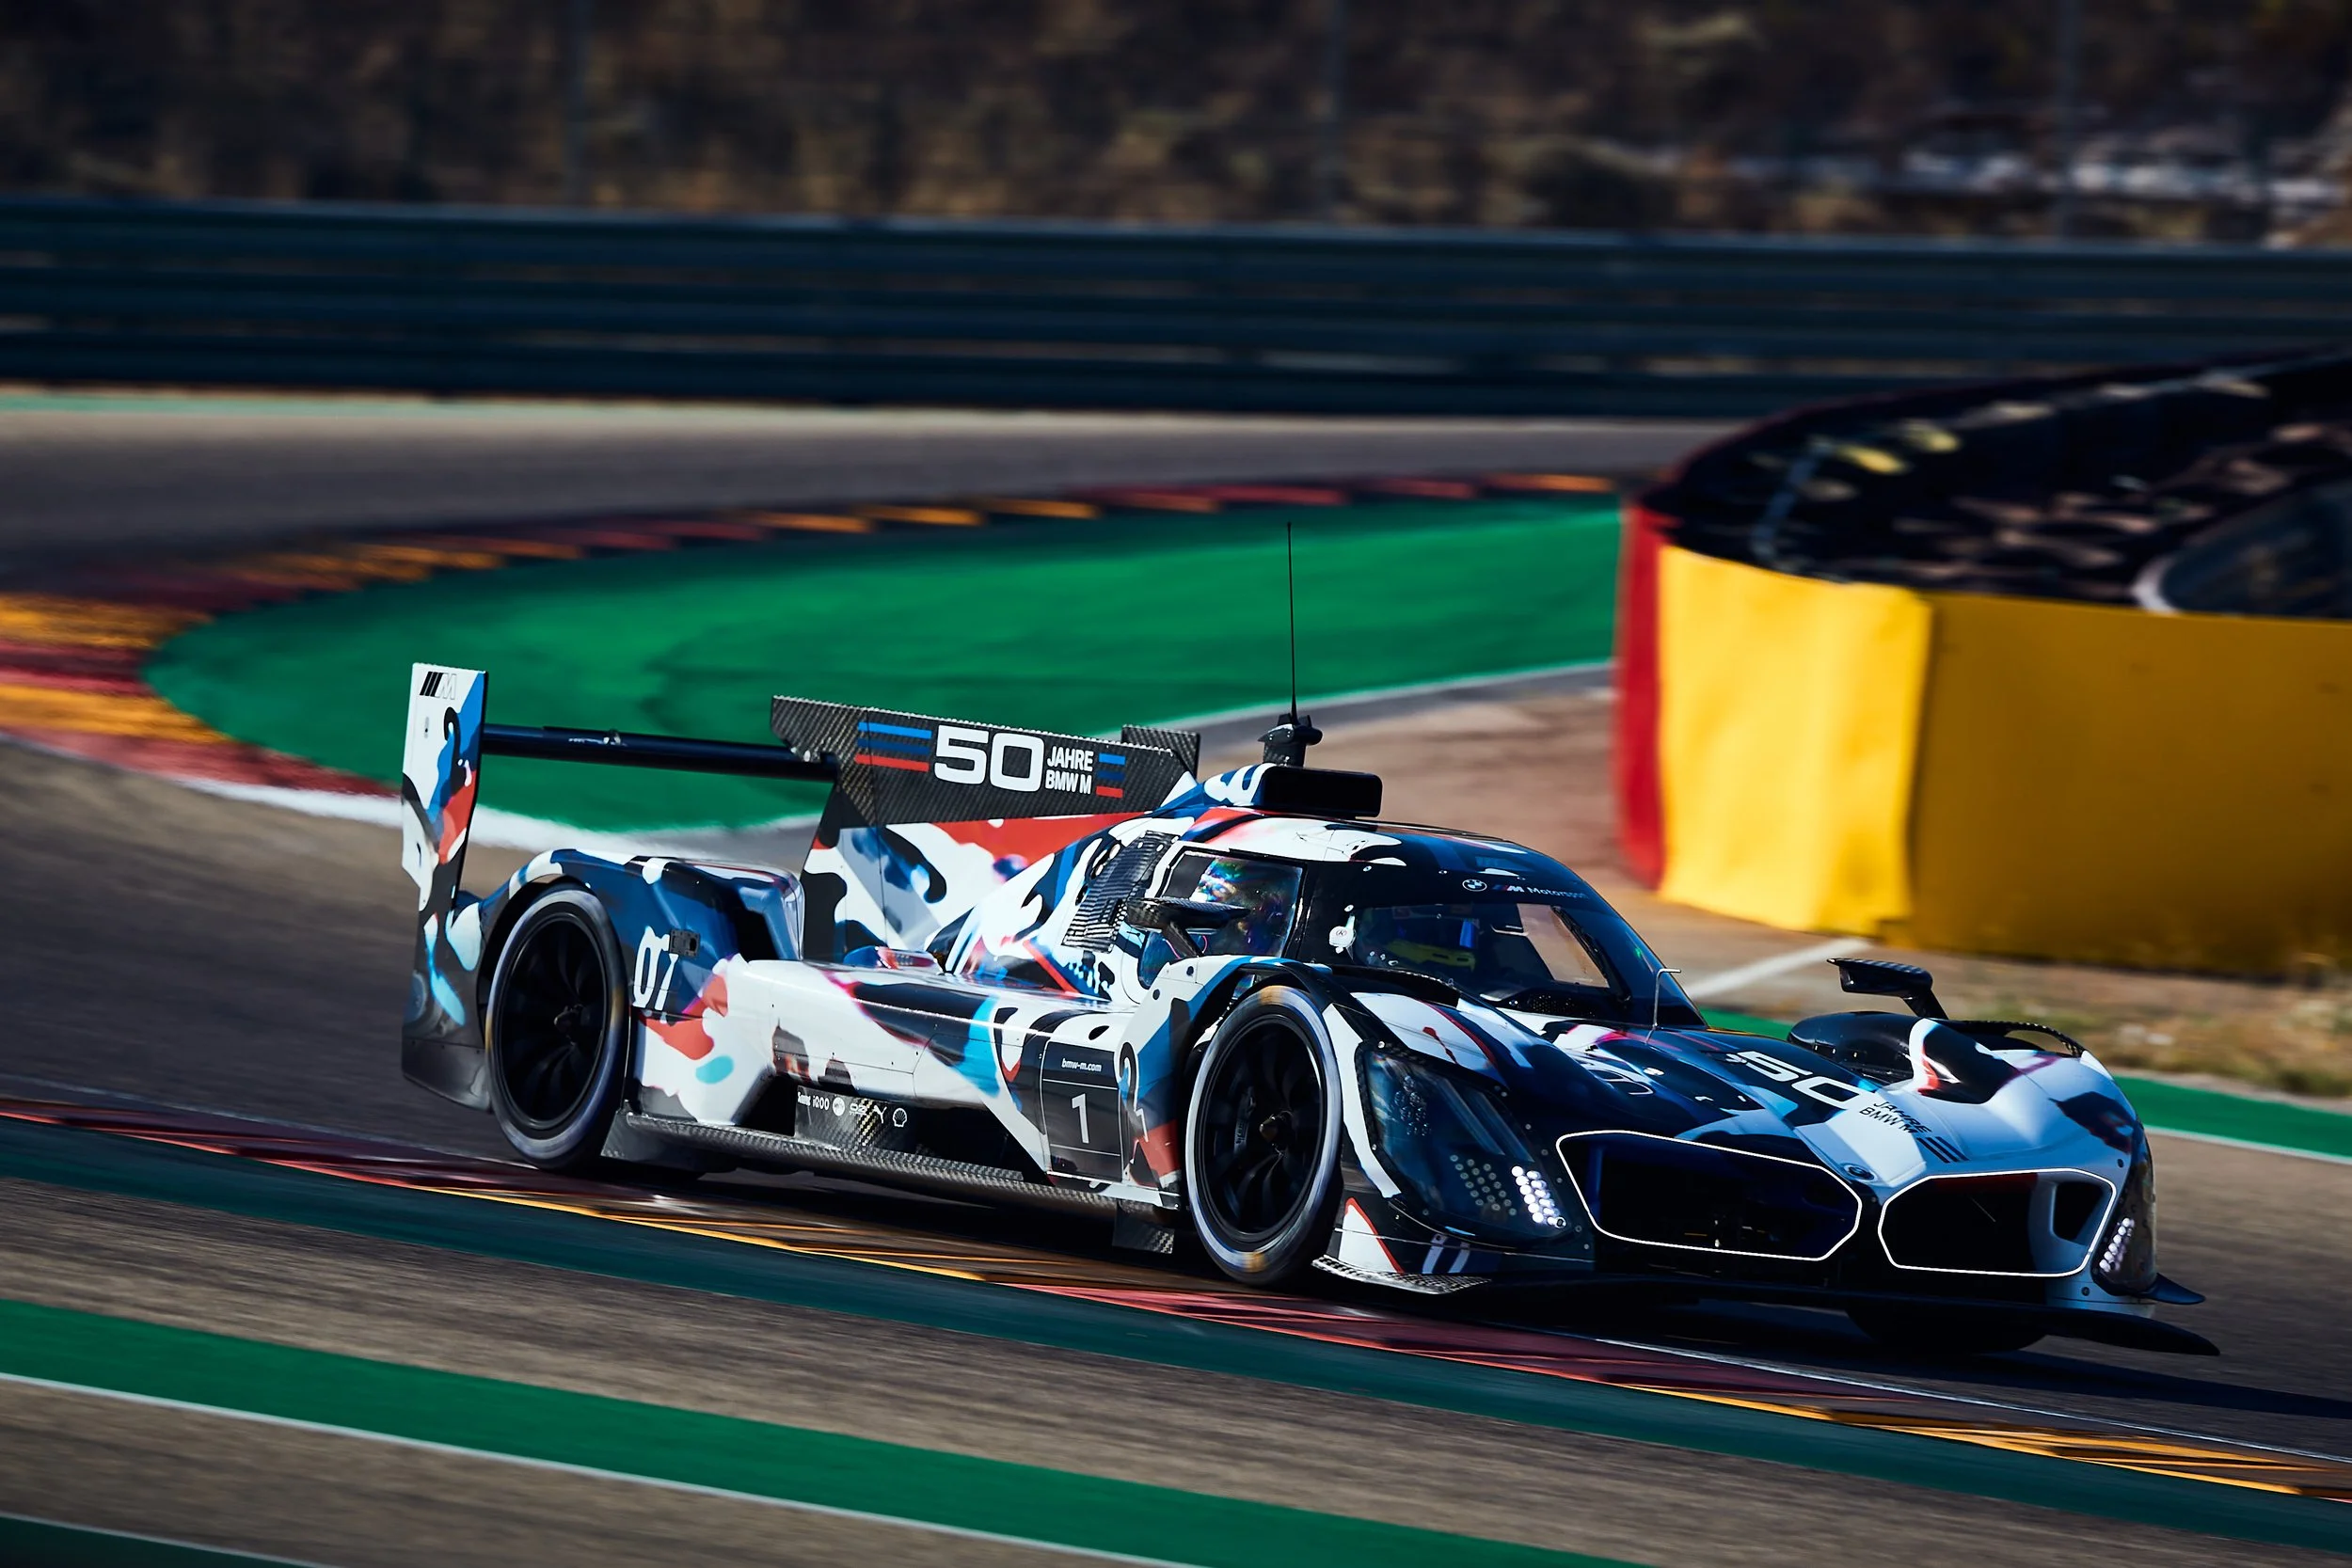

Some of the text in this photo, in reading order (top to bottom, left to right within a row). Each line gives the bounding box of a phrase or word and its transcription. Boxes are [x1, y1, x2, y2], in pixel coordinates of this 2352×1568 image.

[934, 725, 1044, 792] 50
[1046, 746, 1094, 772] JAHRE
[1044, 769, 1093, 795] BMW M
[1526, 886, 1590, 899] Motorspo
[632, 926, 679, 1011] 07
[1061, 1058, 1102, 1072] bmw-m.com
[1737, 1051, 1863, 1110] 50
[1072, 1093, 1089, 1144] 1
[1859, 1107, 1919, 1133] BMW M
[1874, 1101, 1932, 1132] JAHRE
